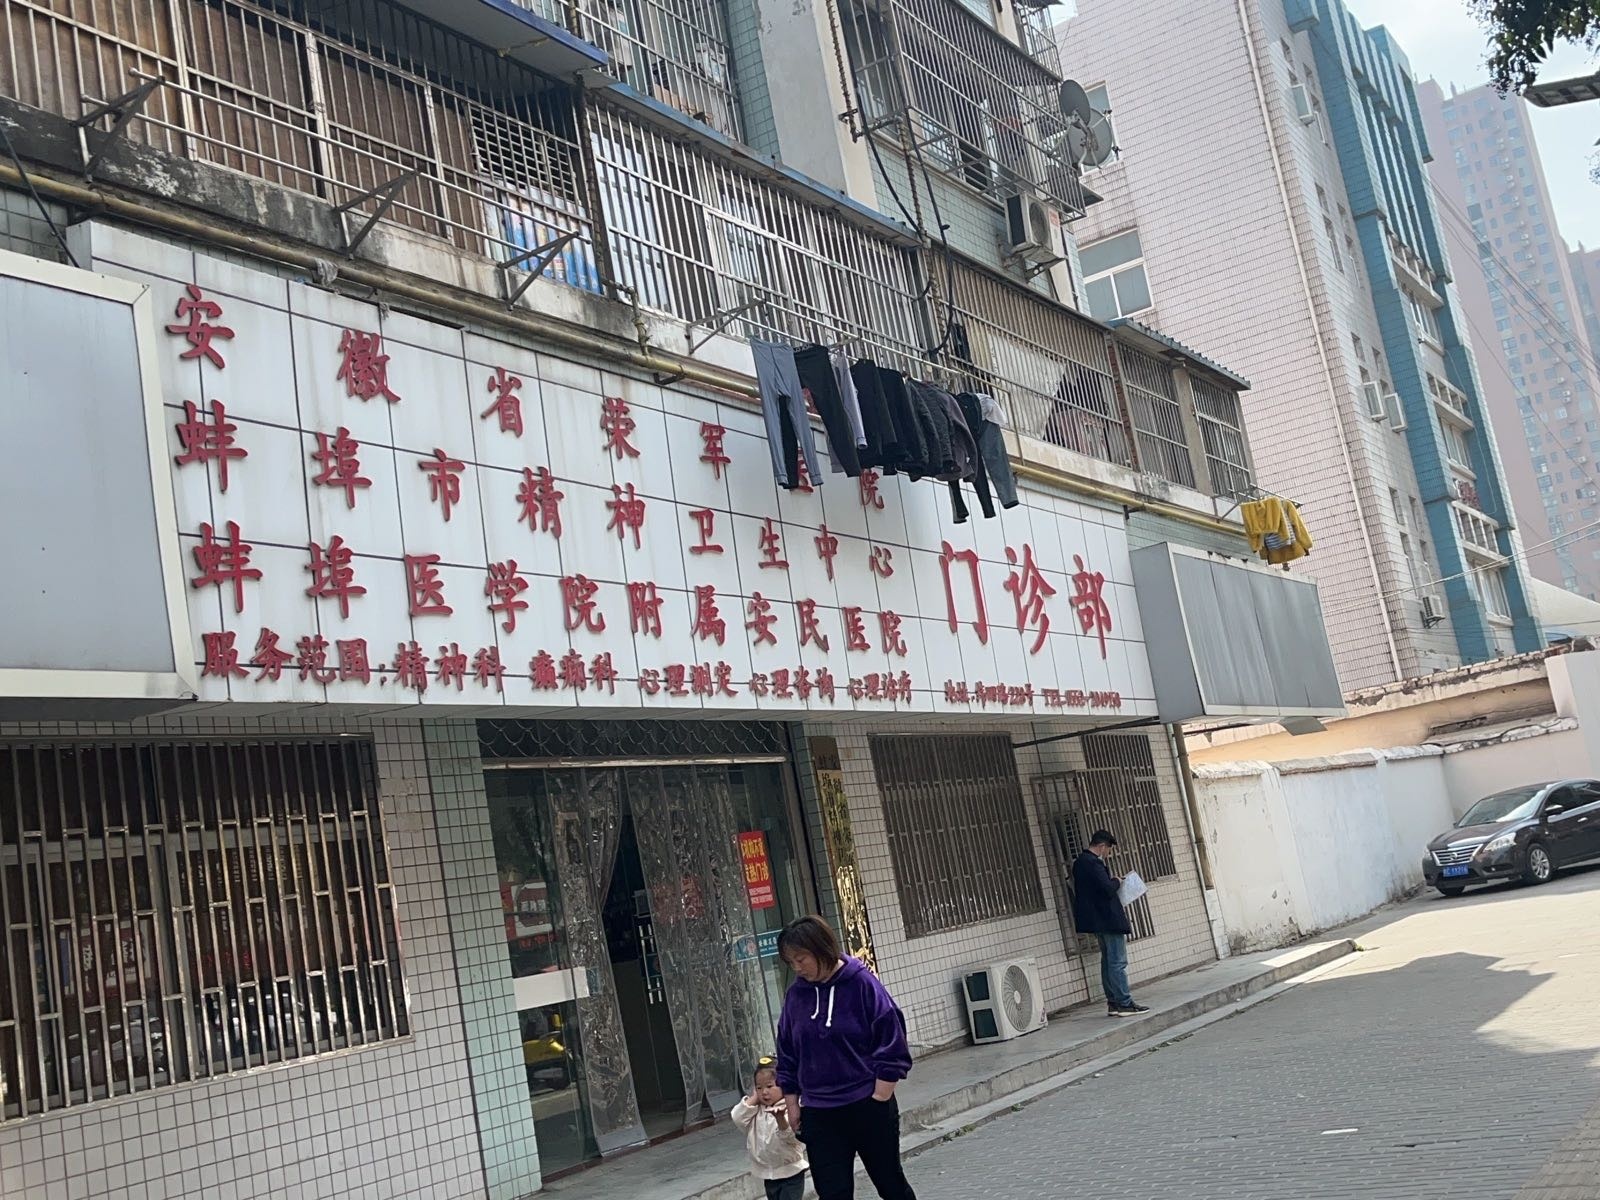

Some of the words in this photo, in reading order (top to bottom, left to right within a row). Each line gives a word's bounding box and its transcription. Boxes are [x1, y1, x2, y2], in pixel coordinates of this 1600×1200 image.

[174, 399, 894, 580] 蚌埠市精神卫生中心
[191, 520, 908, 658] 蚌埠医学院附属安民医院
[939, 540, 1112, 660] 门诊部
